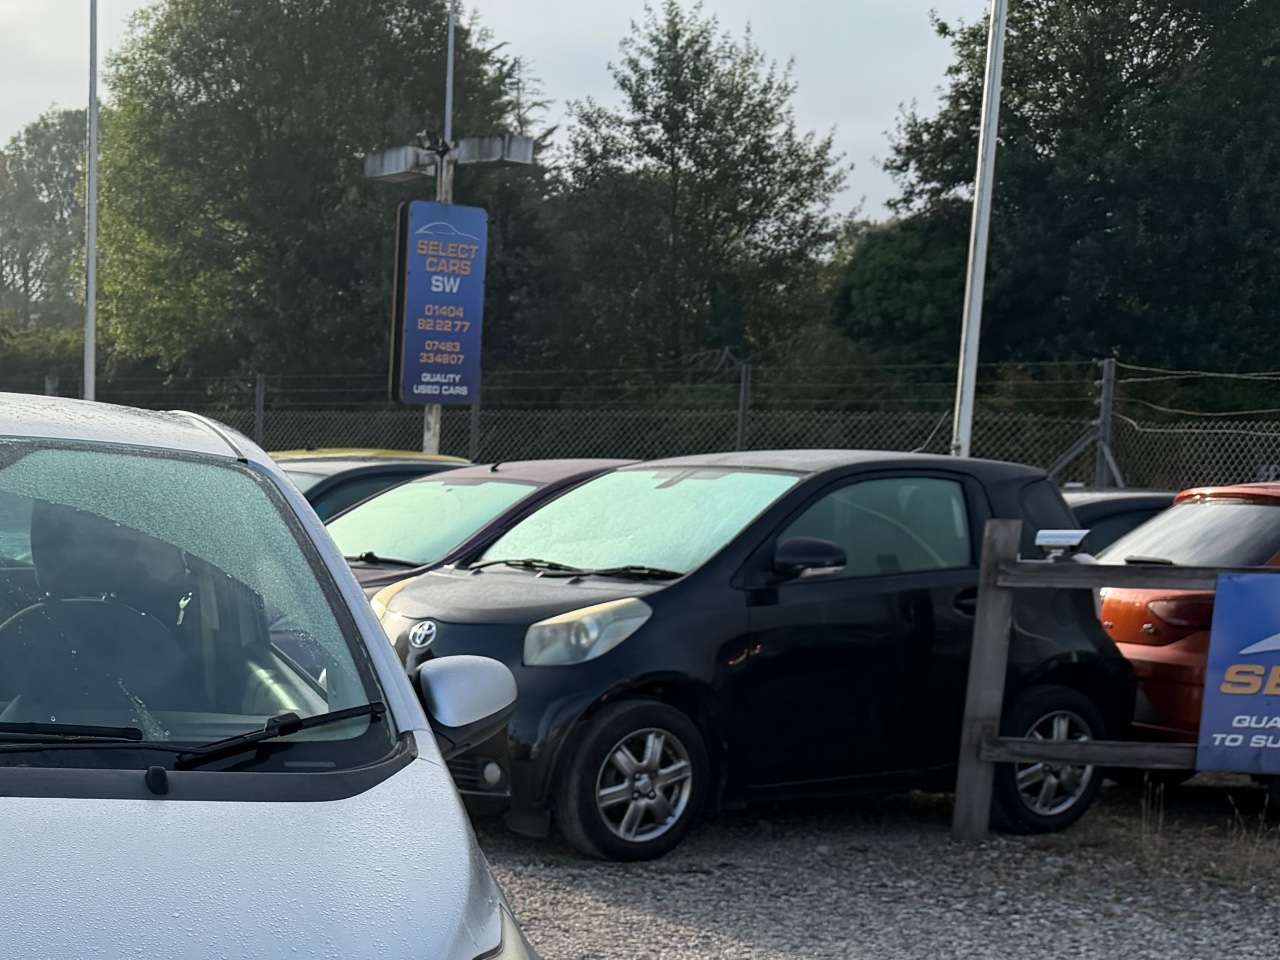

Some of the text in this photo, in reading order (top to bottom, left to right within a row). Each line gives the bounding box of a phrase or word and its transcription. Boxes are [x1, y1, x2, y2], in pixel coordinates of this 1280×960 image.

[417, 240, 479, 258] SELECT
[426, 257, 472, 275] CARS
[431, 275, 461, 293] SW
[424, 304, 464, 318] 01404
[421, 372, 462, 383] QUALITY
[413, 384, 468, 396] USED CARS
[1212, 733, 1280, 748] TO SU
